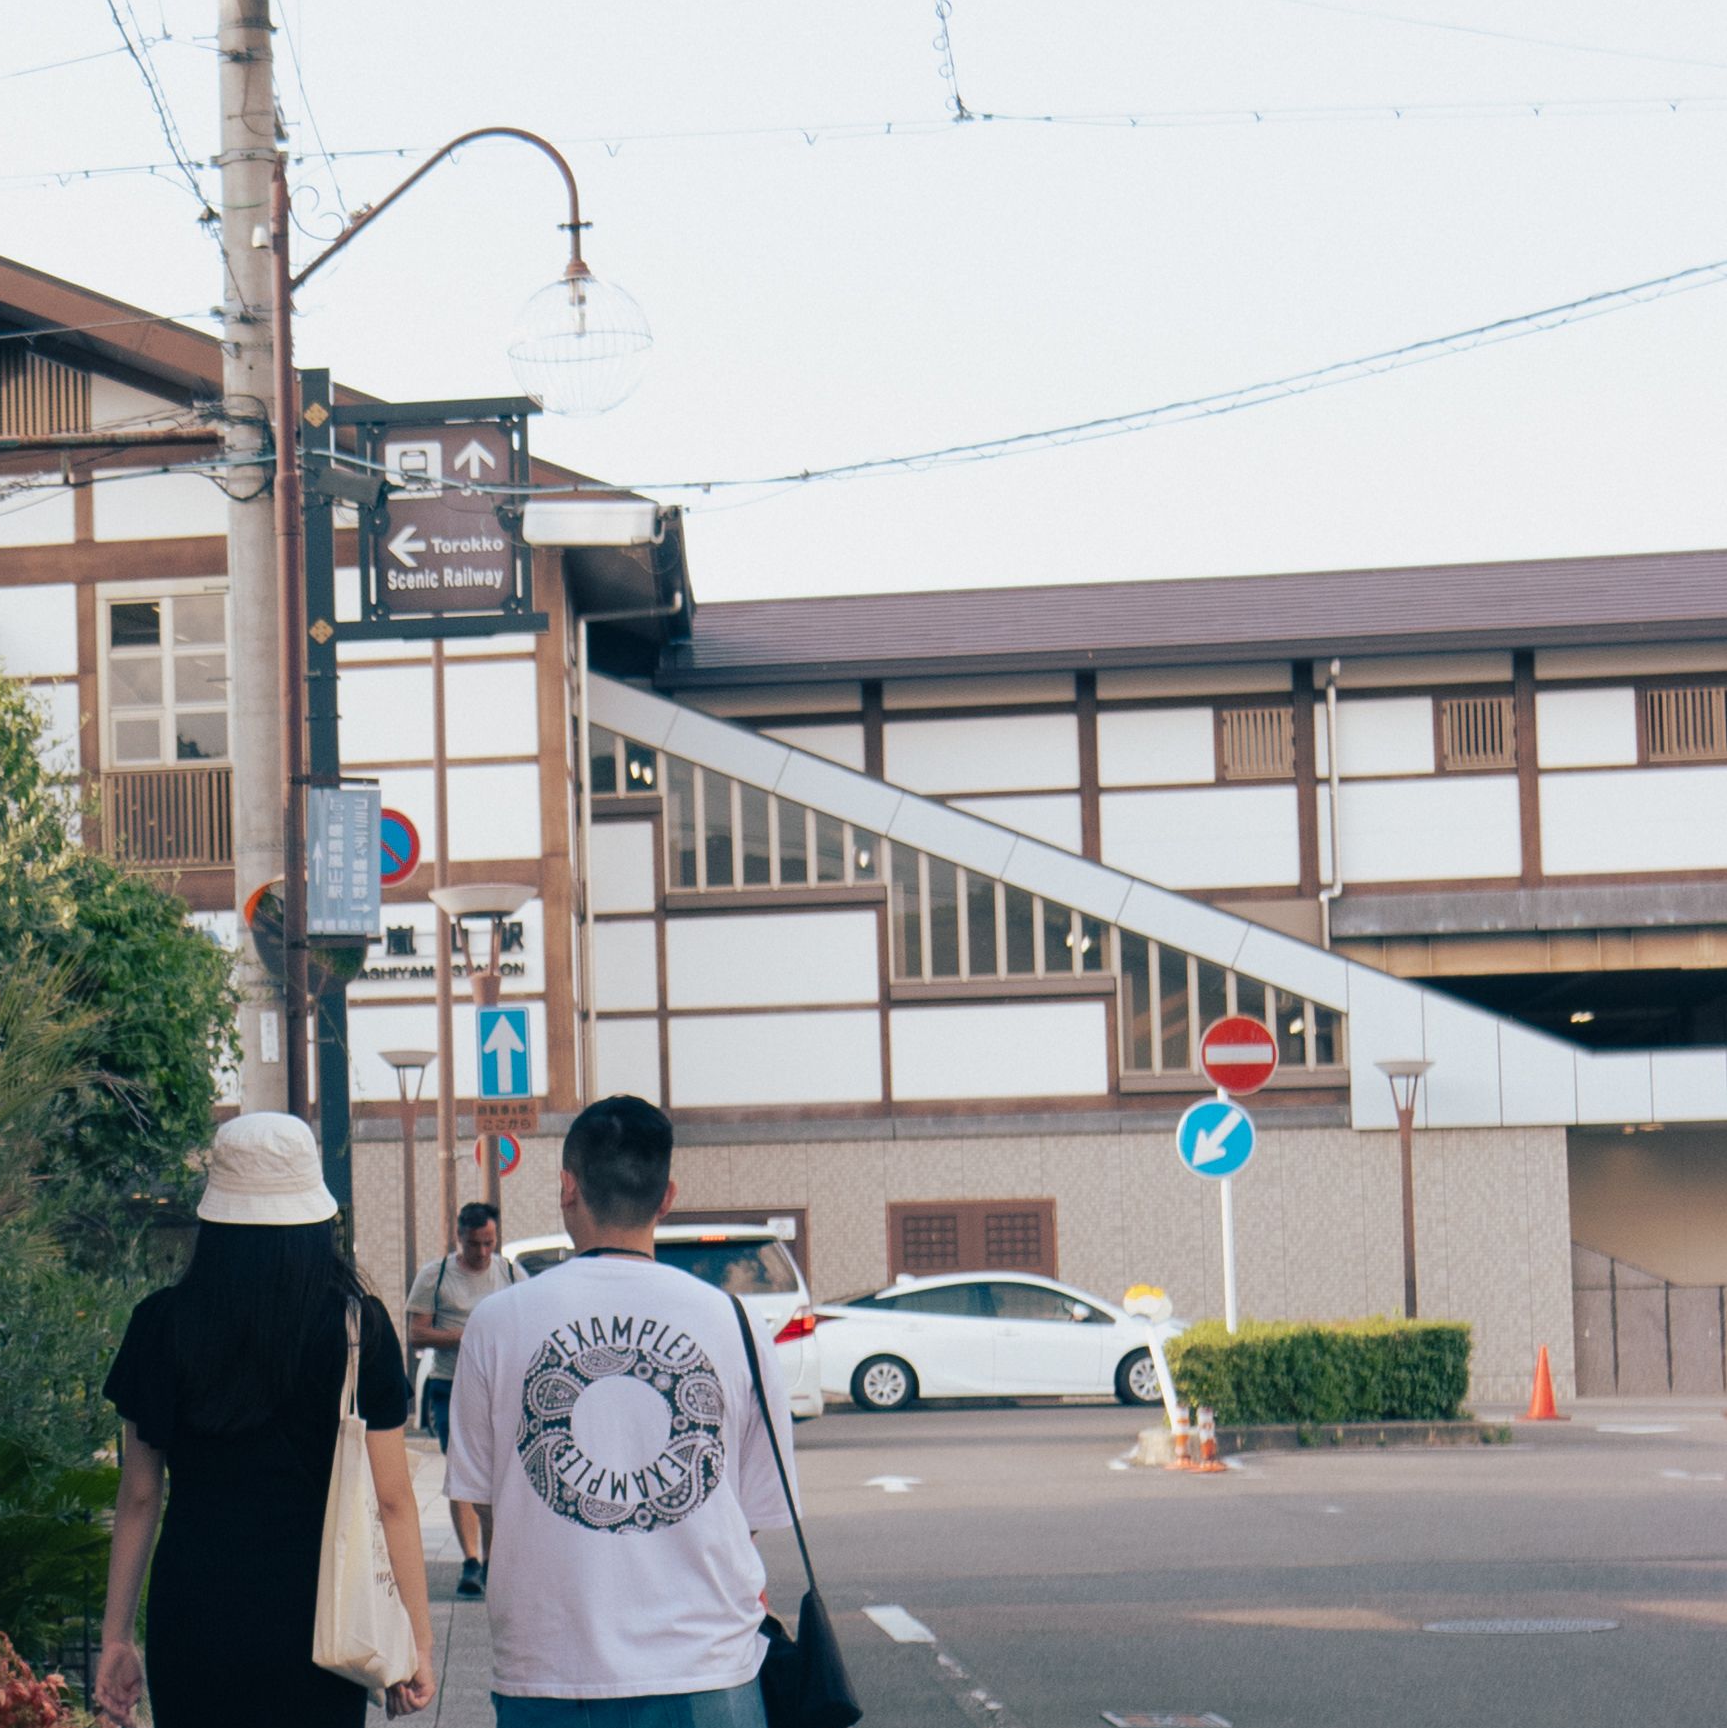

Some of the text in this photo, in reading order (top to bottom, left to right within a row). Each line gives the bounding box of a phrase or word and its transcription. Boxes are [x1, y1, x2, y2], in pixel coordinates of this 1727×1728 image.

[430, 537, 505, 554] Torokko
[387, 567, 504, 590] Scenic Railway
[483, 1118, 532, 1131] ここから
[551, 1315, 691, 1362] EXAMPLE
[558, 1446, 690, 1502] EXAMPLE
